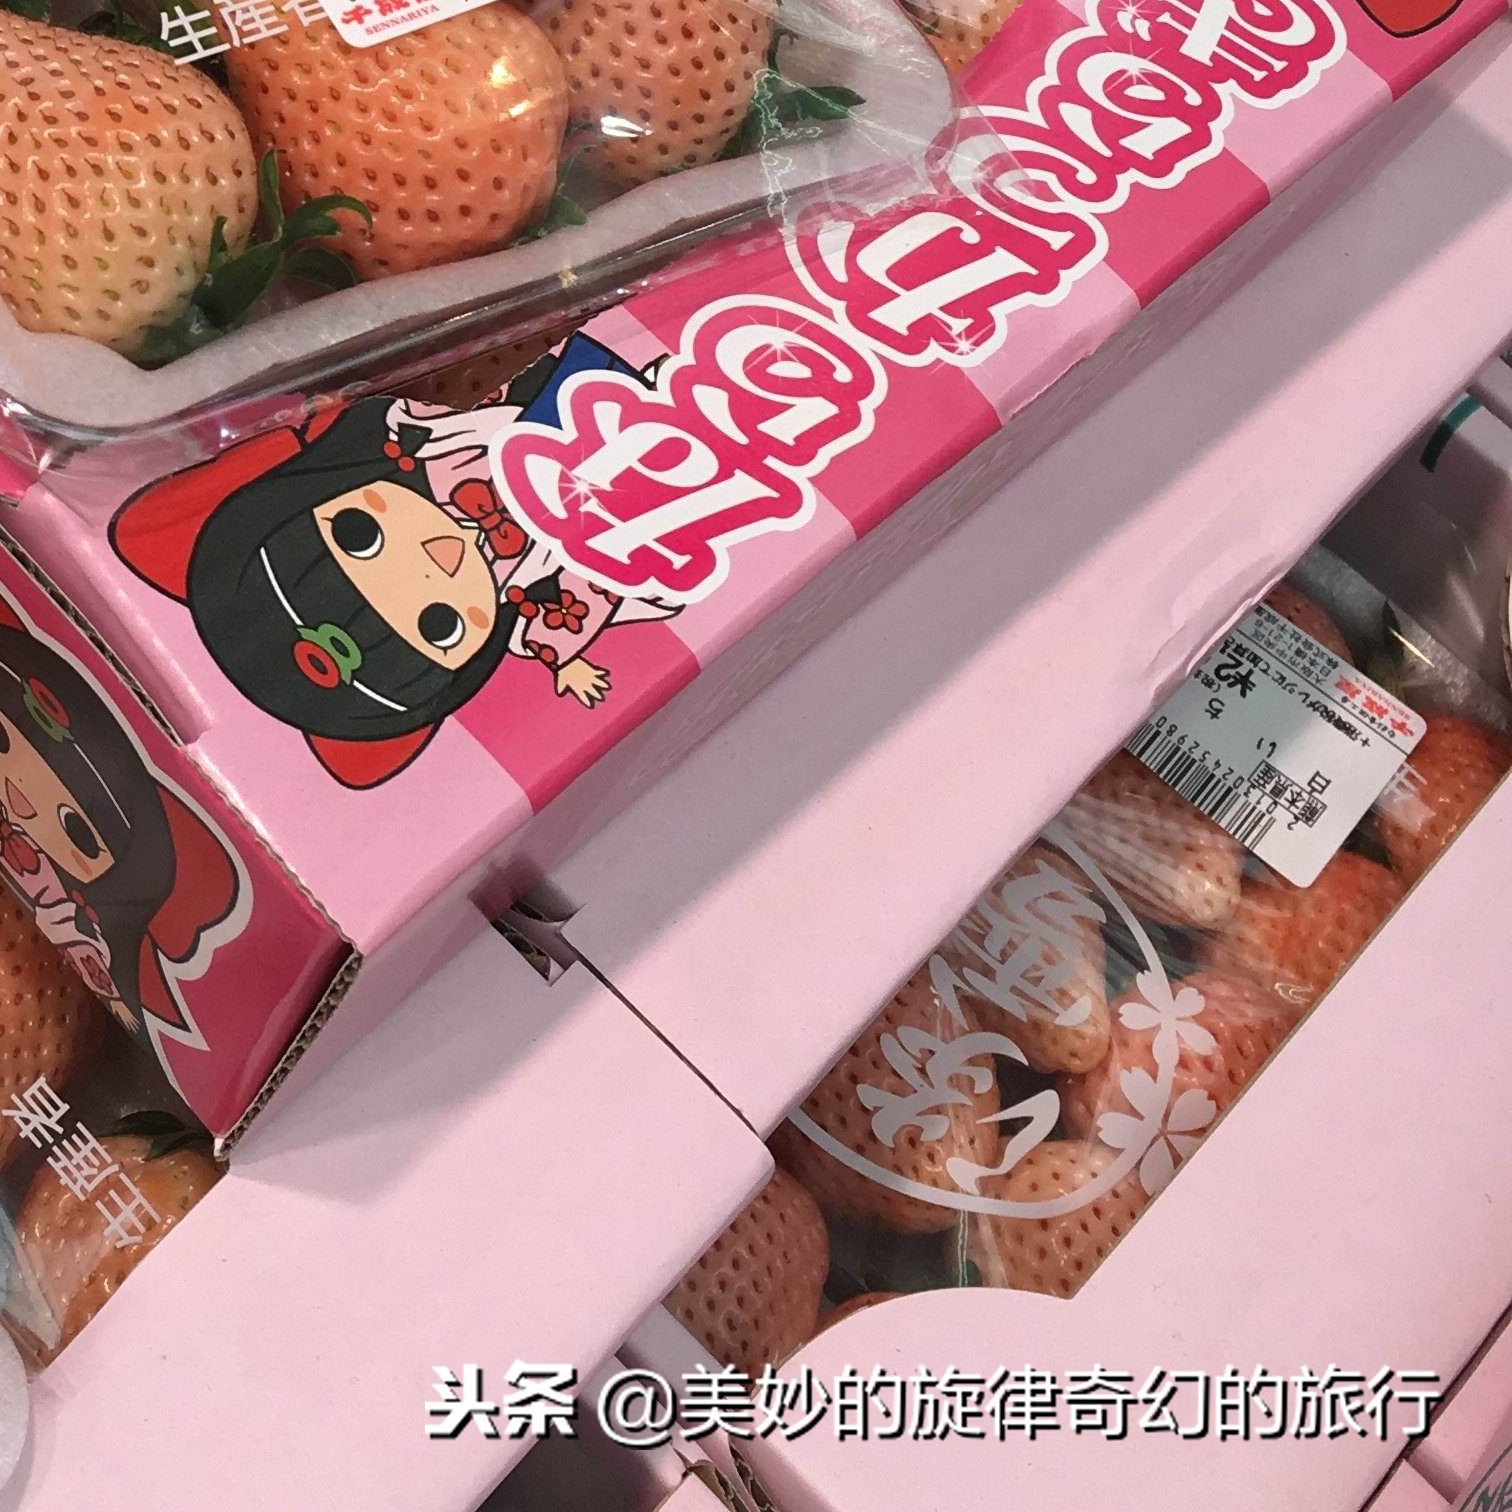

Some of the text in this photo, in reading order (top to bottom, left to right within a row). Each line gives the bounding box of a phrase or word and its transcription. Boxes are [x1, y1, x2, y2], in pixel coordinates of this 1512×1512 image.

[362, 1, 441, 37] SENNARIYA
[1249, 627, 1326, 687] 大阪市中央区
[1252, 616, 1332, 679] 日本橋1-21-6
[1248, 759, 1324, 826] 熊本県産
[0, 1073, 163, 1250] 生産者
